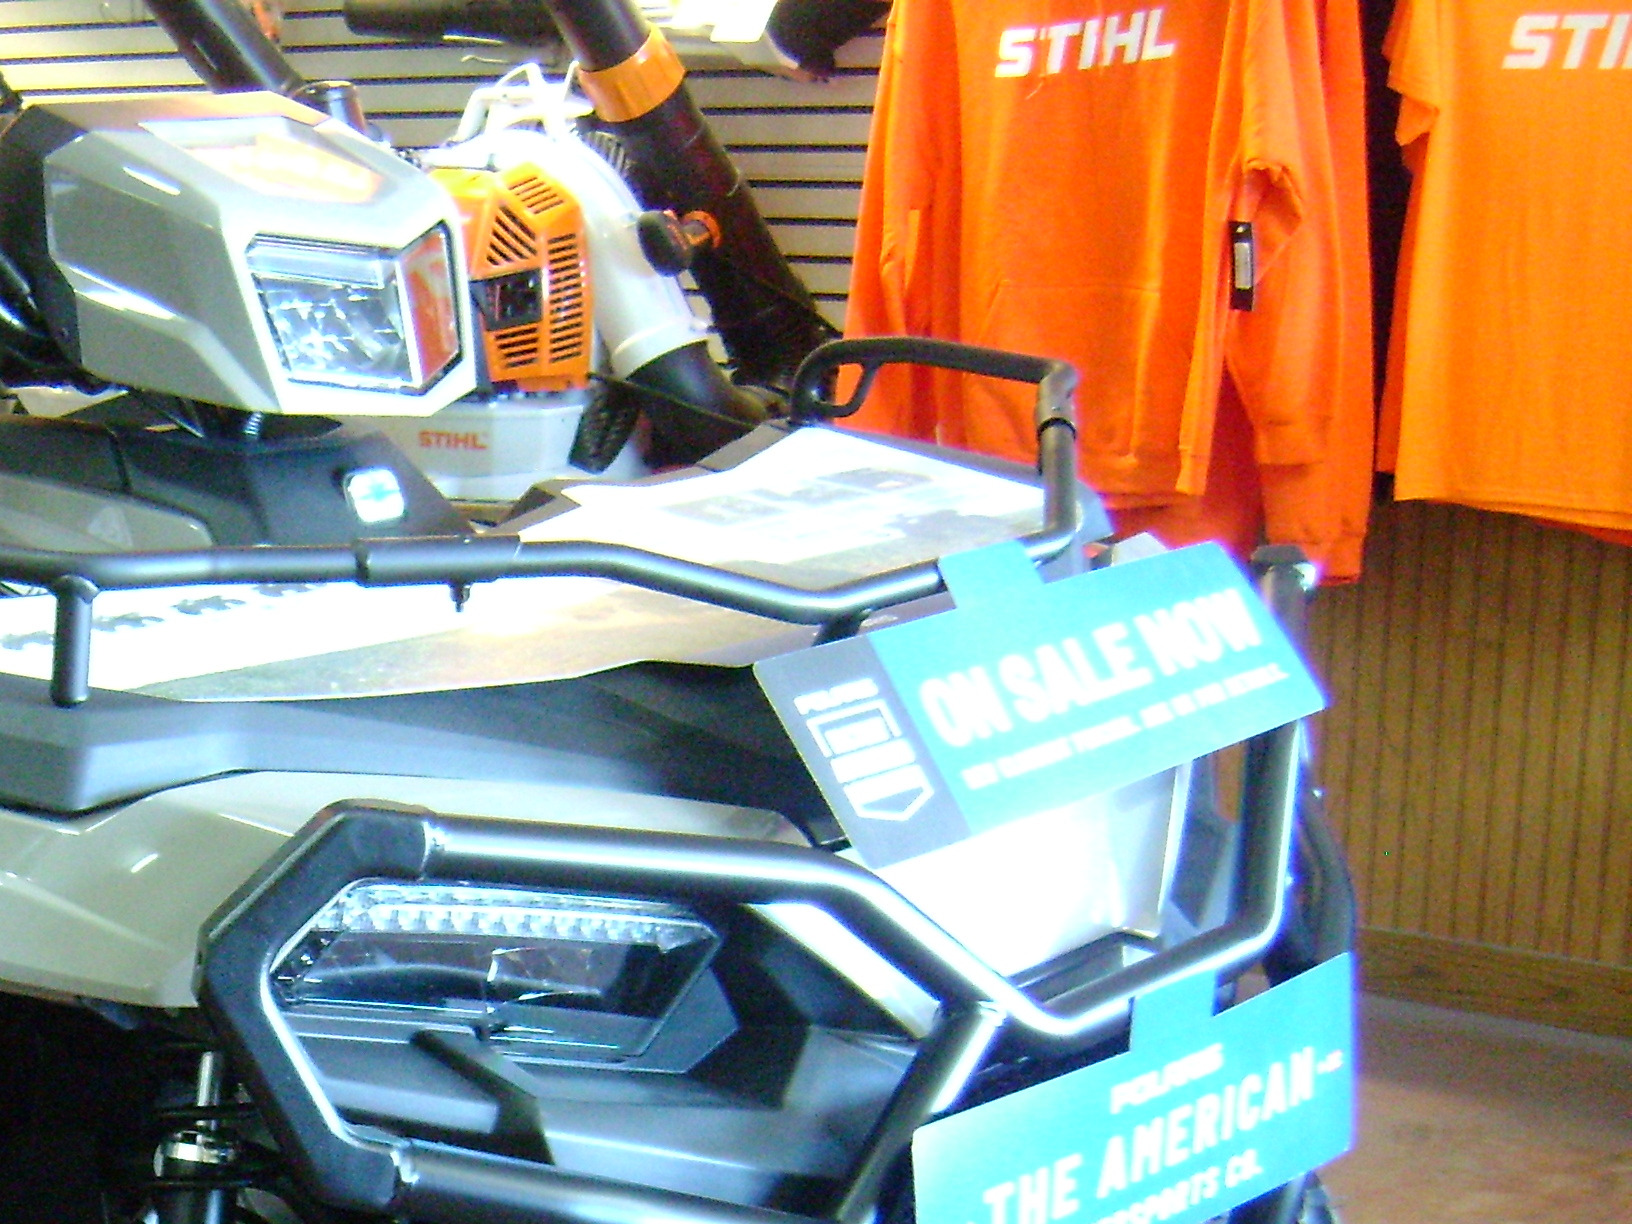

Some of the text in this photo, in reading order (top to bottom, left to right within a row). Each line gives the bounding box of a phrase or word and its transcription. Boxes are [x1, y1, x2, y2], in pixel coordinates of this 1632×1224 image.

[994, 8, 1176, 78] STIHL
[1501, 13, 1632, 70] STI
[418, 429, 488, 450] STIHL
[918, 665, 1013, 748] ON
[998, 621, 1155, 725] SALE
[1133, 586, 1263, 677] NOW
[1095, 1046, 1315, 1200] AMERICAN
